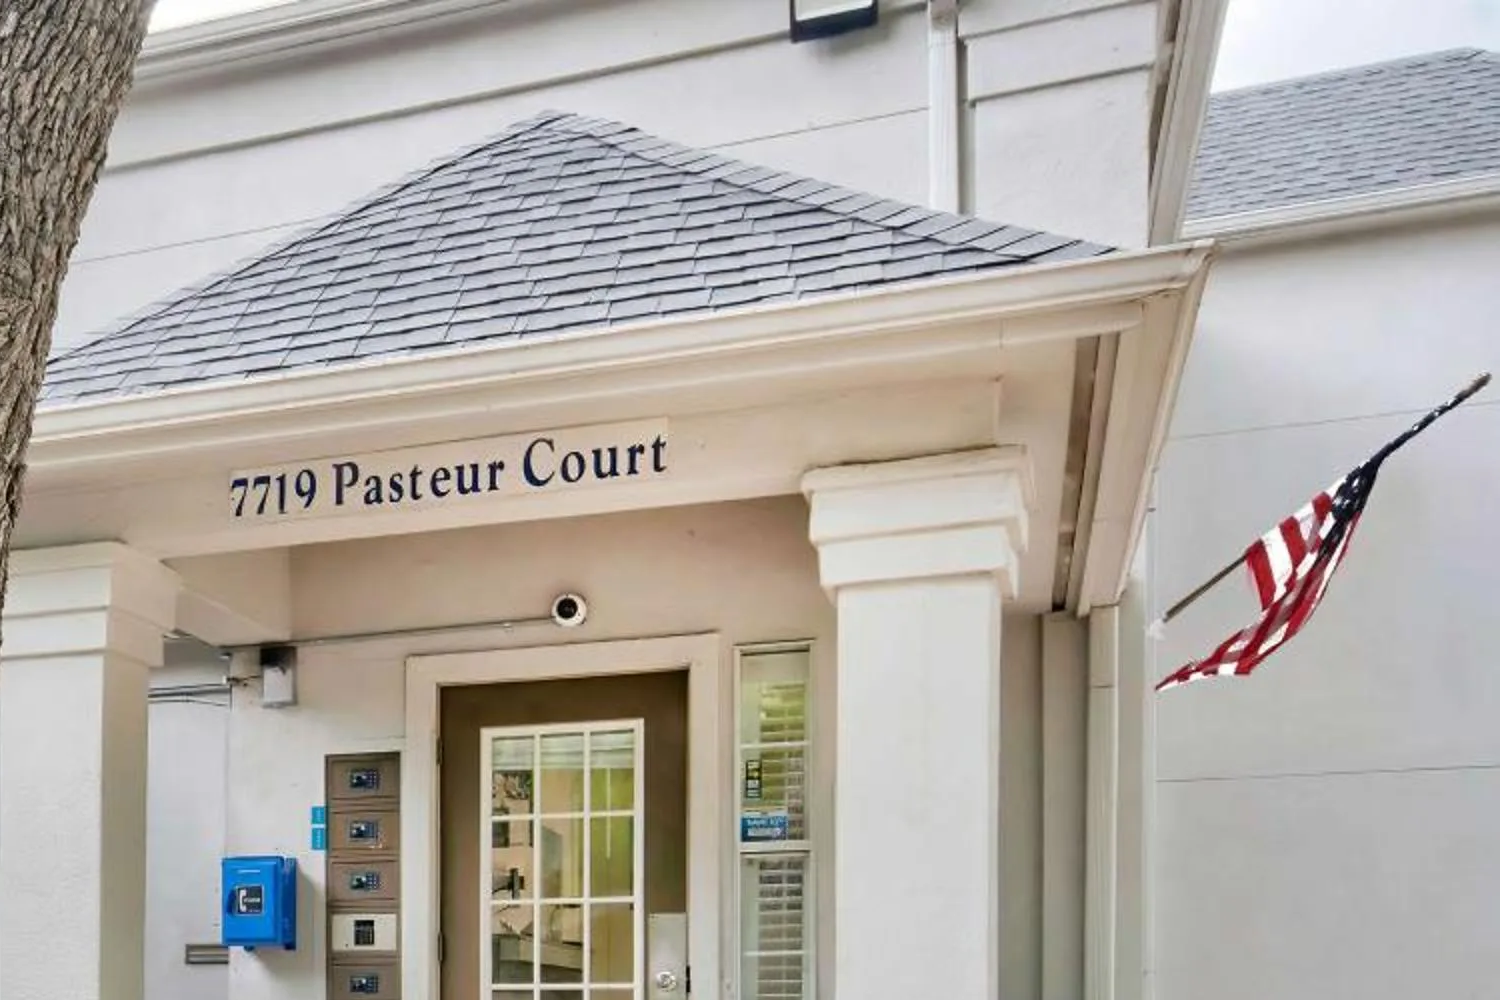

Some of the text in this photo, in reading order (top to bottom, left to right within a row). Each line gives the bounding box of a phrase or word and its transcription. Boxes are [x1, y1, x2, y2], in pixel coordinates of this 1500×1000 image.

[230, 436, 668, 517] 7719 Pasteur Court
